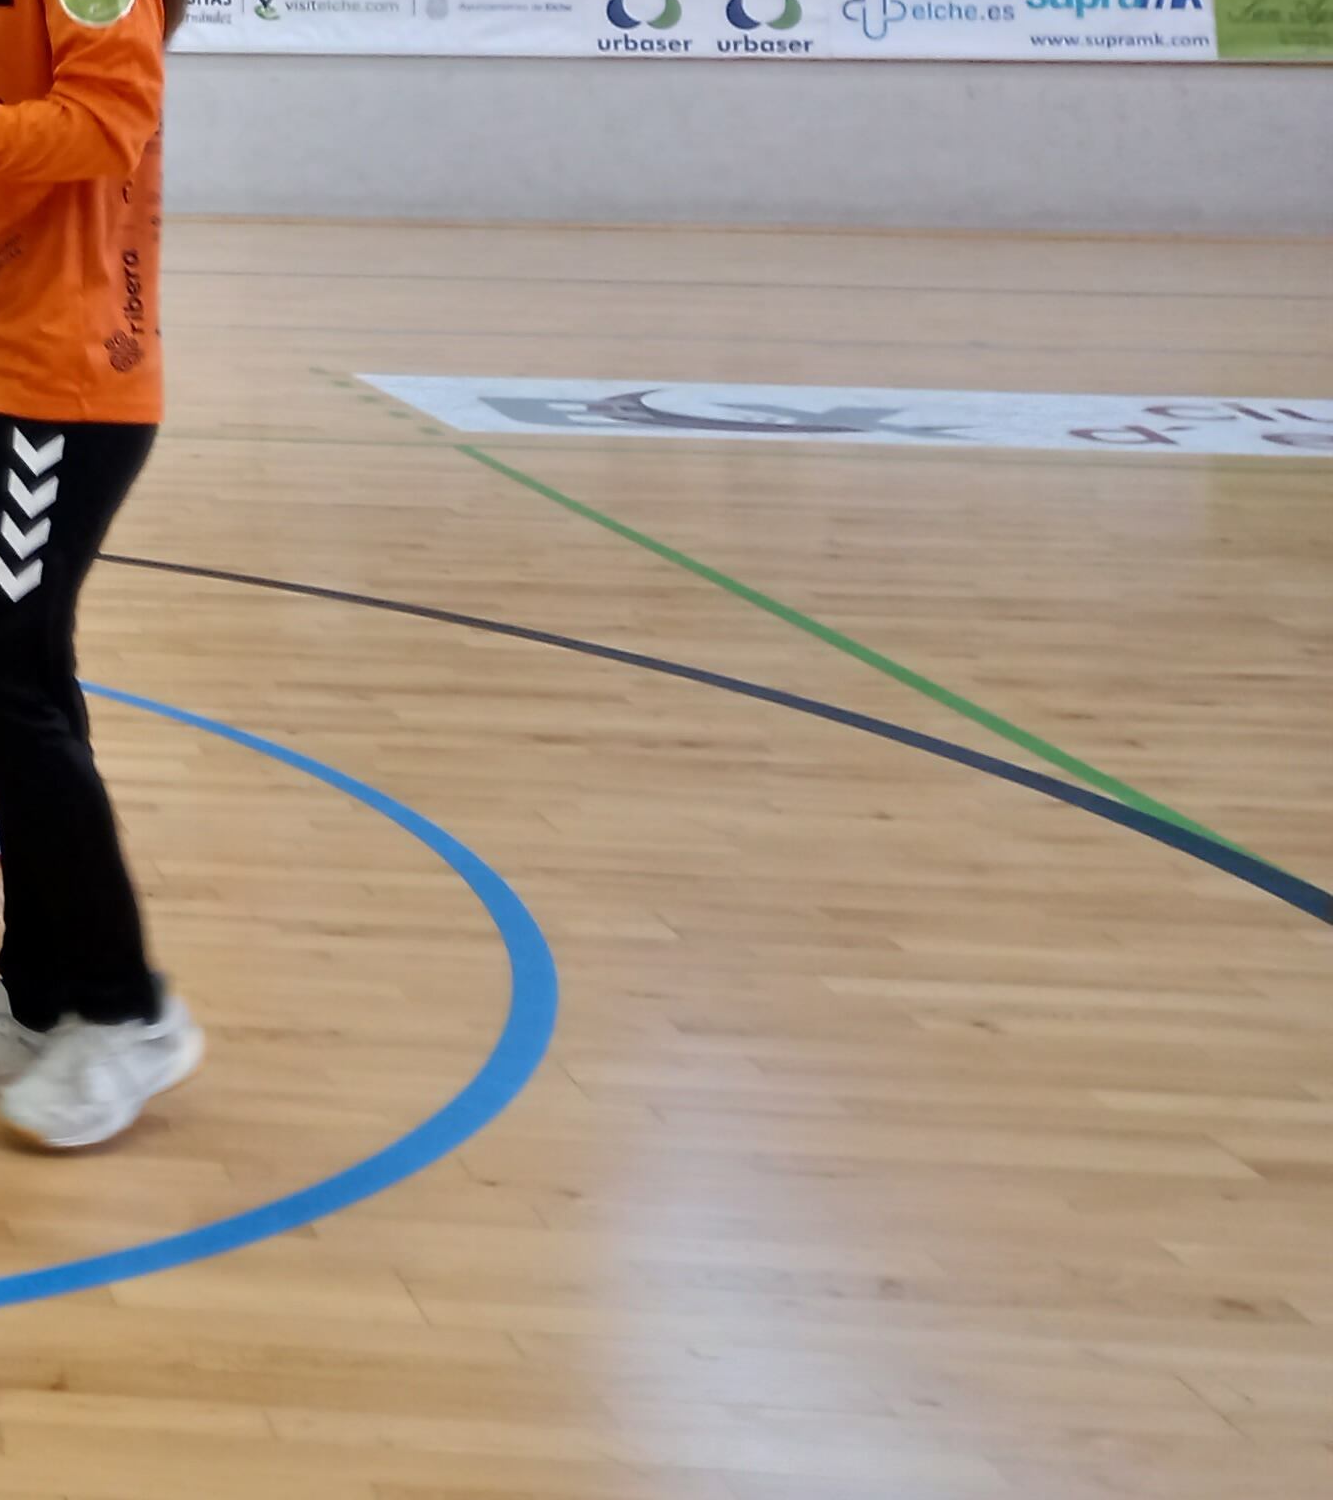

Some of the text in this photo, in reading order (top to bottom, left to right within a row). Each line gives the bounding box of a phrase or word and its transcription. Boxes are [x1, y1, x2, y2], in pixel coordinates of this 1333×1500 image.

[911, 1, 1015, 22] elche.es
[597, 35, 692, 54] urbaser
[717, 35, 813, 54] urbaser
[1030, 32, 1210, 50] www.supramk.com
